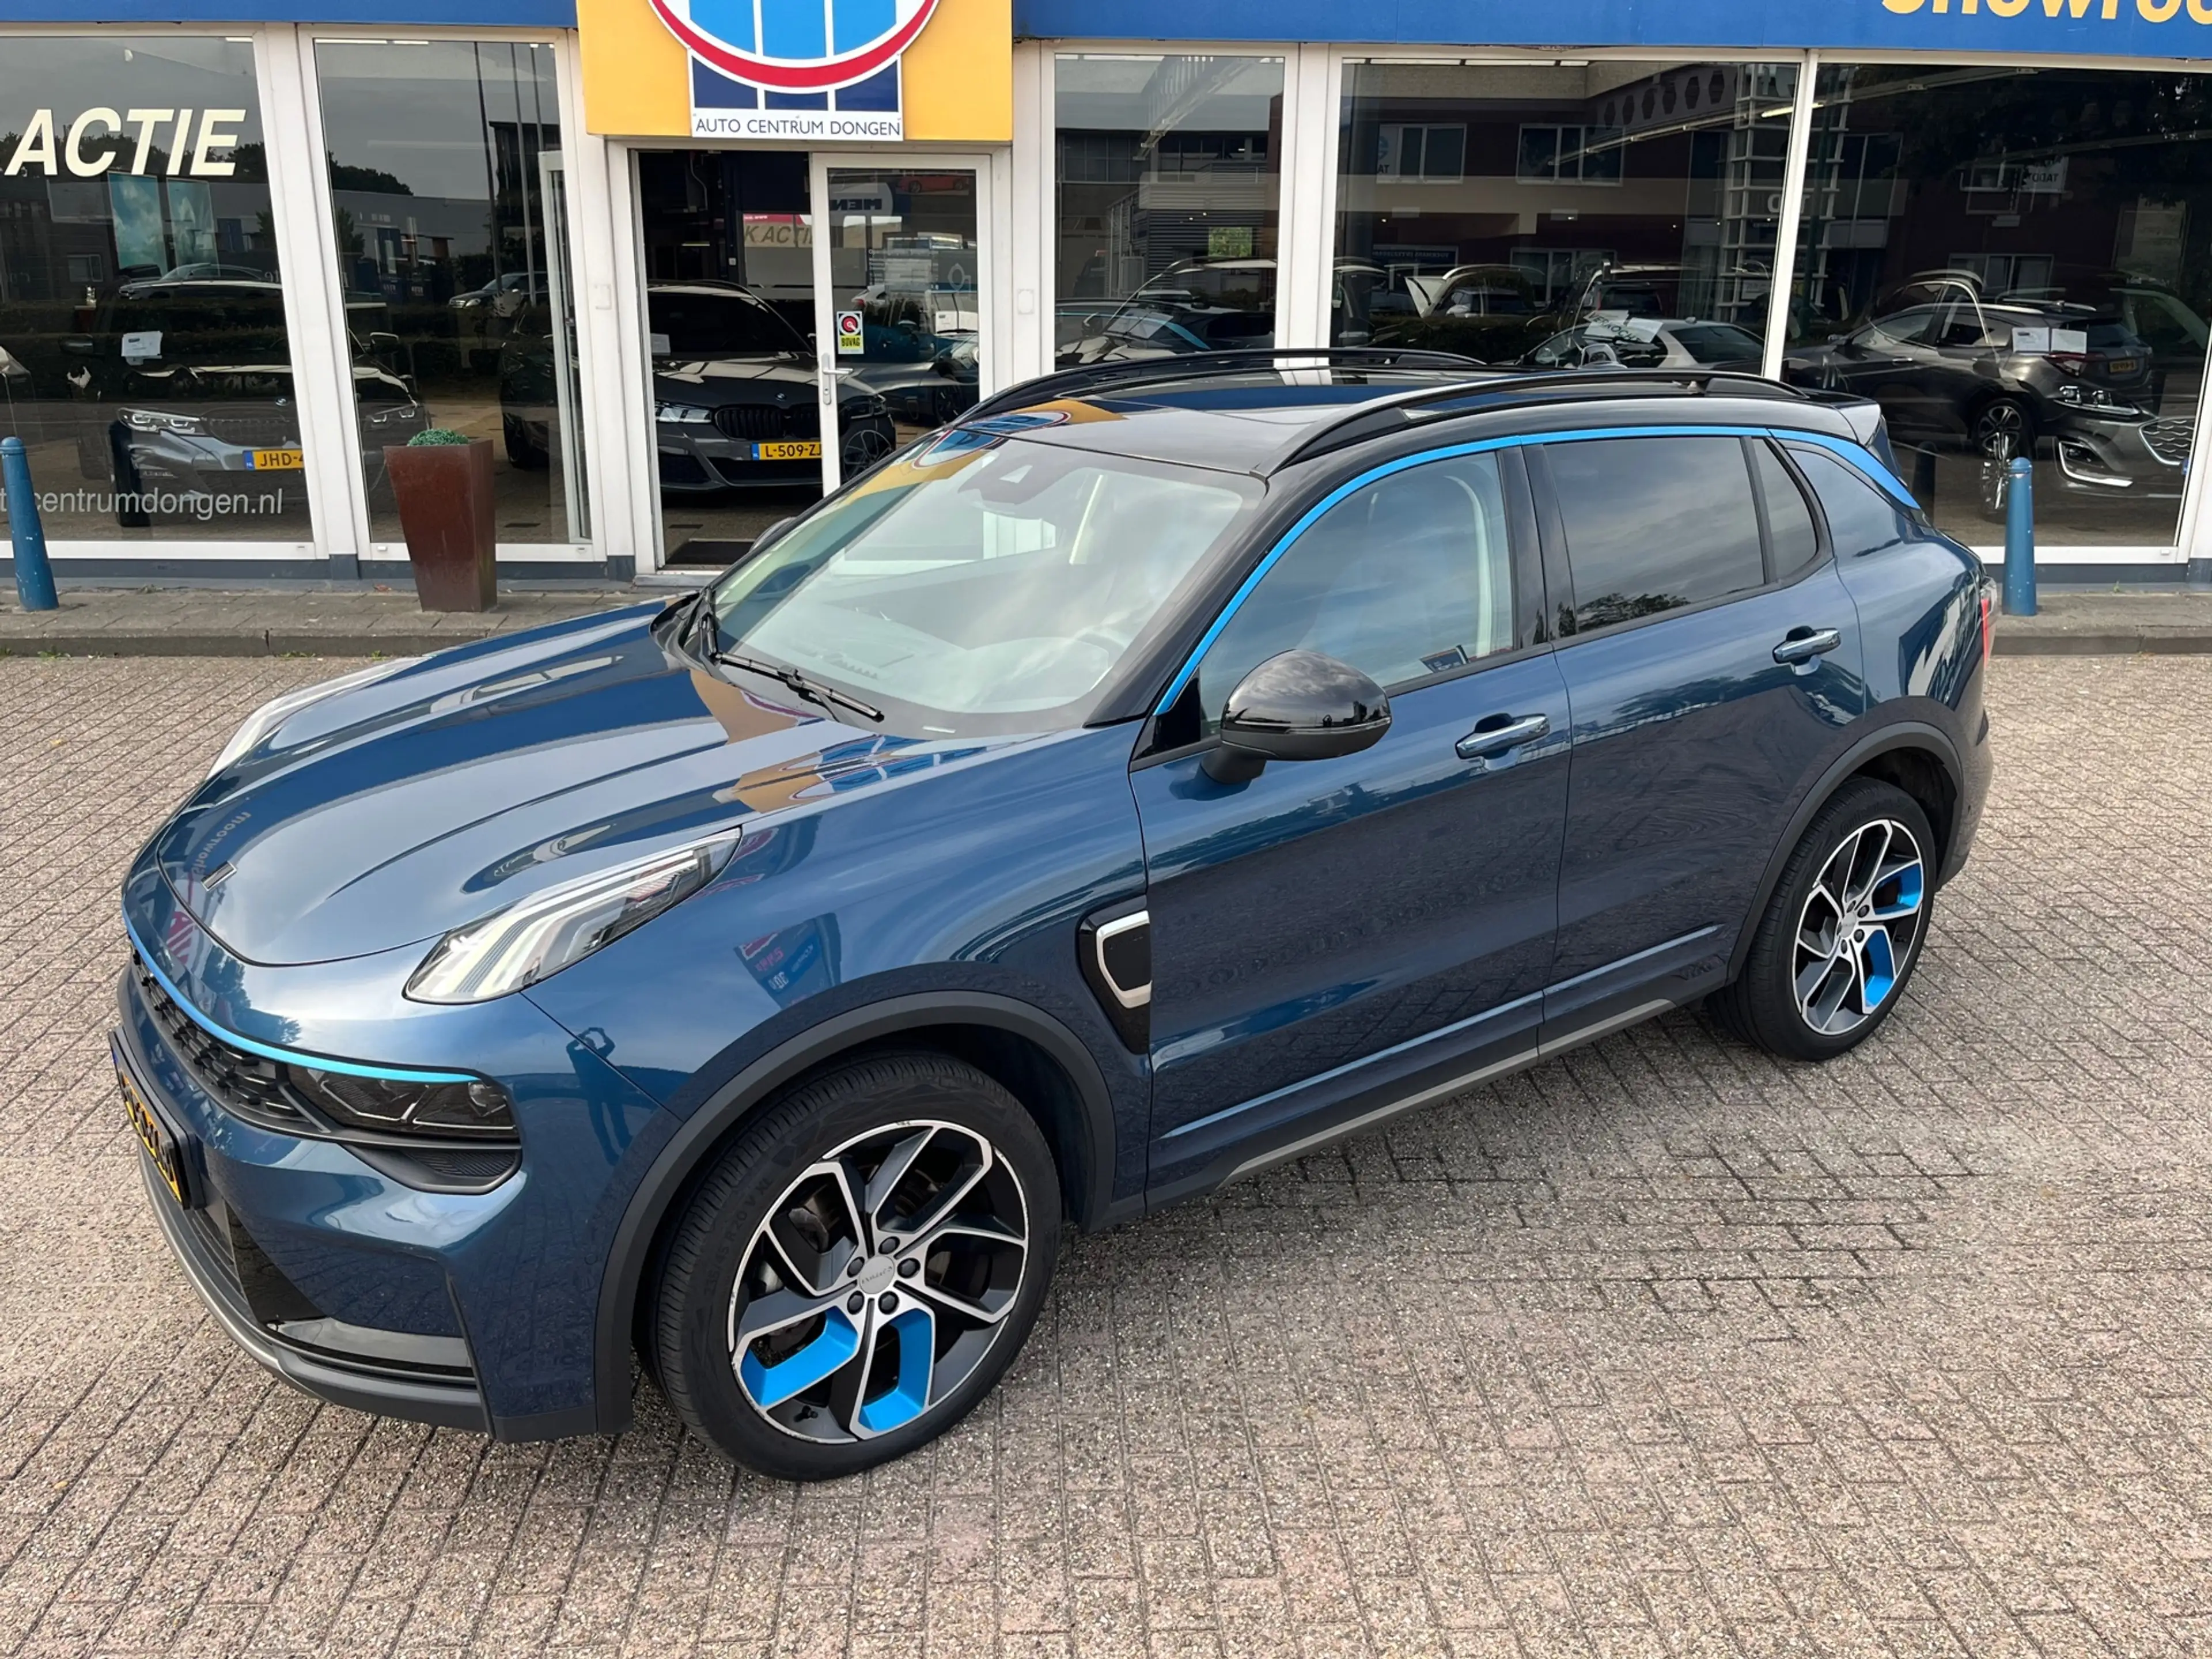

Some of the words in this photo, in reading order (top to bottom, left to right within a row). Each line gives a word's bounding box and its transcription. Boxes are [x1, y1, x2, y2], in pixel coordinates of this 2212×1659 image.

[696, 119, 741, 132] AUTO
[747, 120, 824, 134] CENTRUM
[830, 121, 900, 136] DONGEN
[4, 107, 246, 177] ACTIE
[761, 225, 812, 244] ACTI
[0, 487, 283, 521] tentrumdongen.nl
